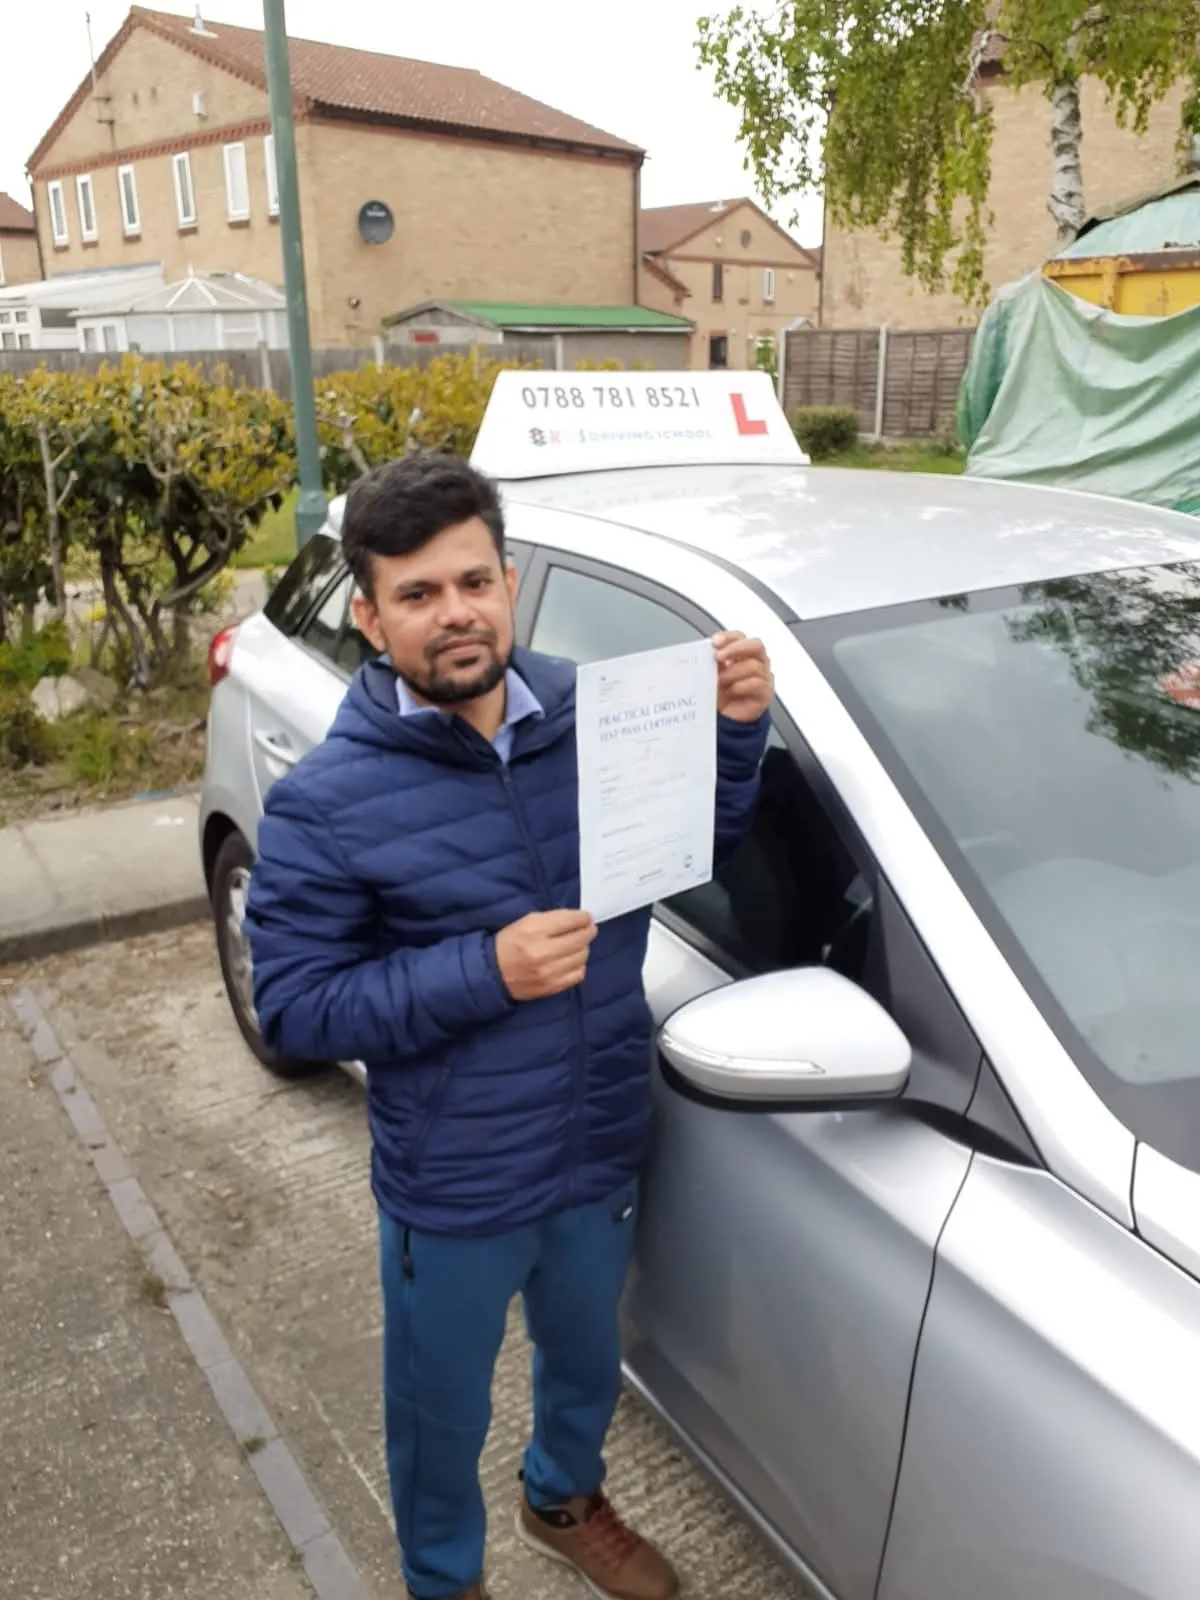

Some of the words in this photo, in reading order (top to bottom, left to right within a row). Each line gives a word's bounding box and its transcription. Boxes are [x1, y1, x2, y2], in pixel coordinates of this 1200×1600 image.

[522, 387, 585, 409] 0788
[592, 387, 636, 408] 781
[645, 387, 700, 408] 8521
[729, 393, 769, 436] L
[588, 429, 655, 442] DRIVING
[598, 706, 650, 728] PRACTICAL
[653, 696, 697, 715] DRIVING
